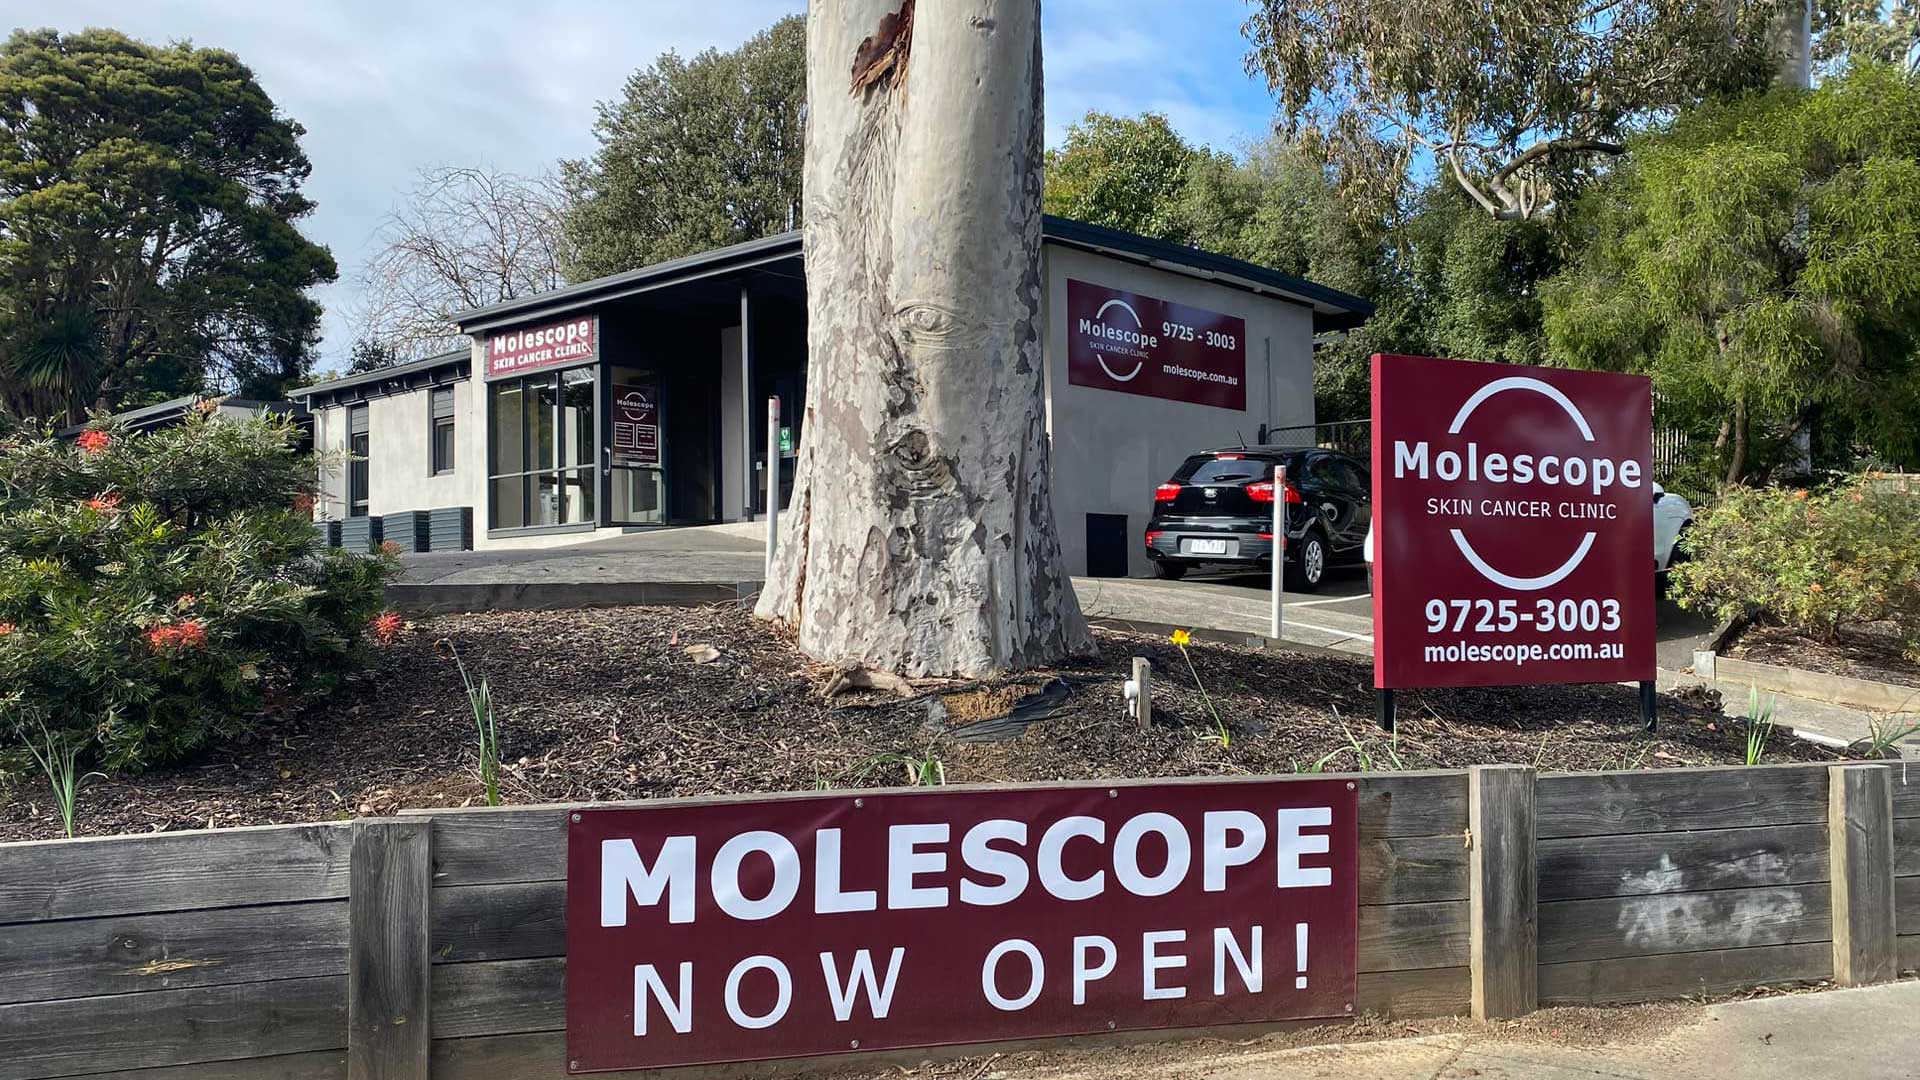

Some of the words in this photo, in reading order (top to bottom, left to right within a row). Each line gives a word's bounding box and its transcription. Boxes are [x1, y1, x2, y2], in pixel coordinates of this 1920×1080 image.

[494, 321, 588, 355] Molescope
[1080, 318, 1157, 349] Molescope
[1162, 321, 1194, 342] 9725
[1206, 330, 1236, 351] 3003
[493, 356, 515, 370] SKIN
[517, 349, 552, 365] CANCER
[555, 341, 587, 358] CLINIC
[1089, 341, 1105, 350] SKIN
[1105, 344, 1128, 355] CANCER
[1129, 348, 1149, 359] CLINIC
[1163, 363, 1238, 386] molescope.com.au
[616, 399, 654, 409] Molescope
[1394, 440, 1641, 495] Molescope
[1427, 498, 1472, 515] SKIN
[1480, 499, 1551, 518] CANCER
[1559, 502, 1617, 520] CLINIC
[1425, 599, 1621, 633] 9725-3003
[1425, 640, 1624, 666] molescope.com.au
[600, 806, 1333, 928] MOLESCOPE
[633, 946, 906, 1038] NOW
[982, 922, 1310, 1012] OPEN!
